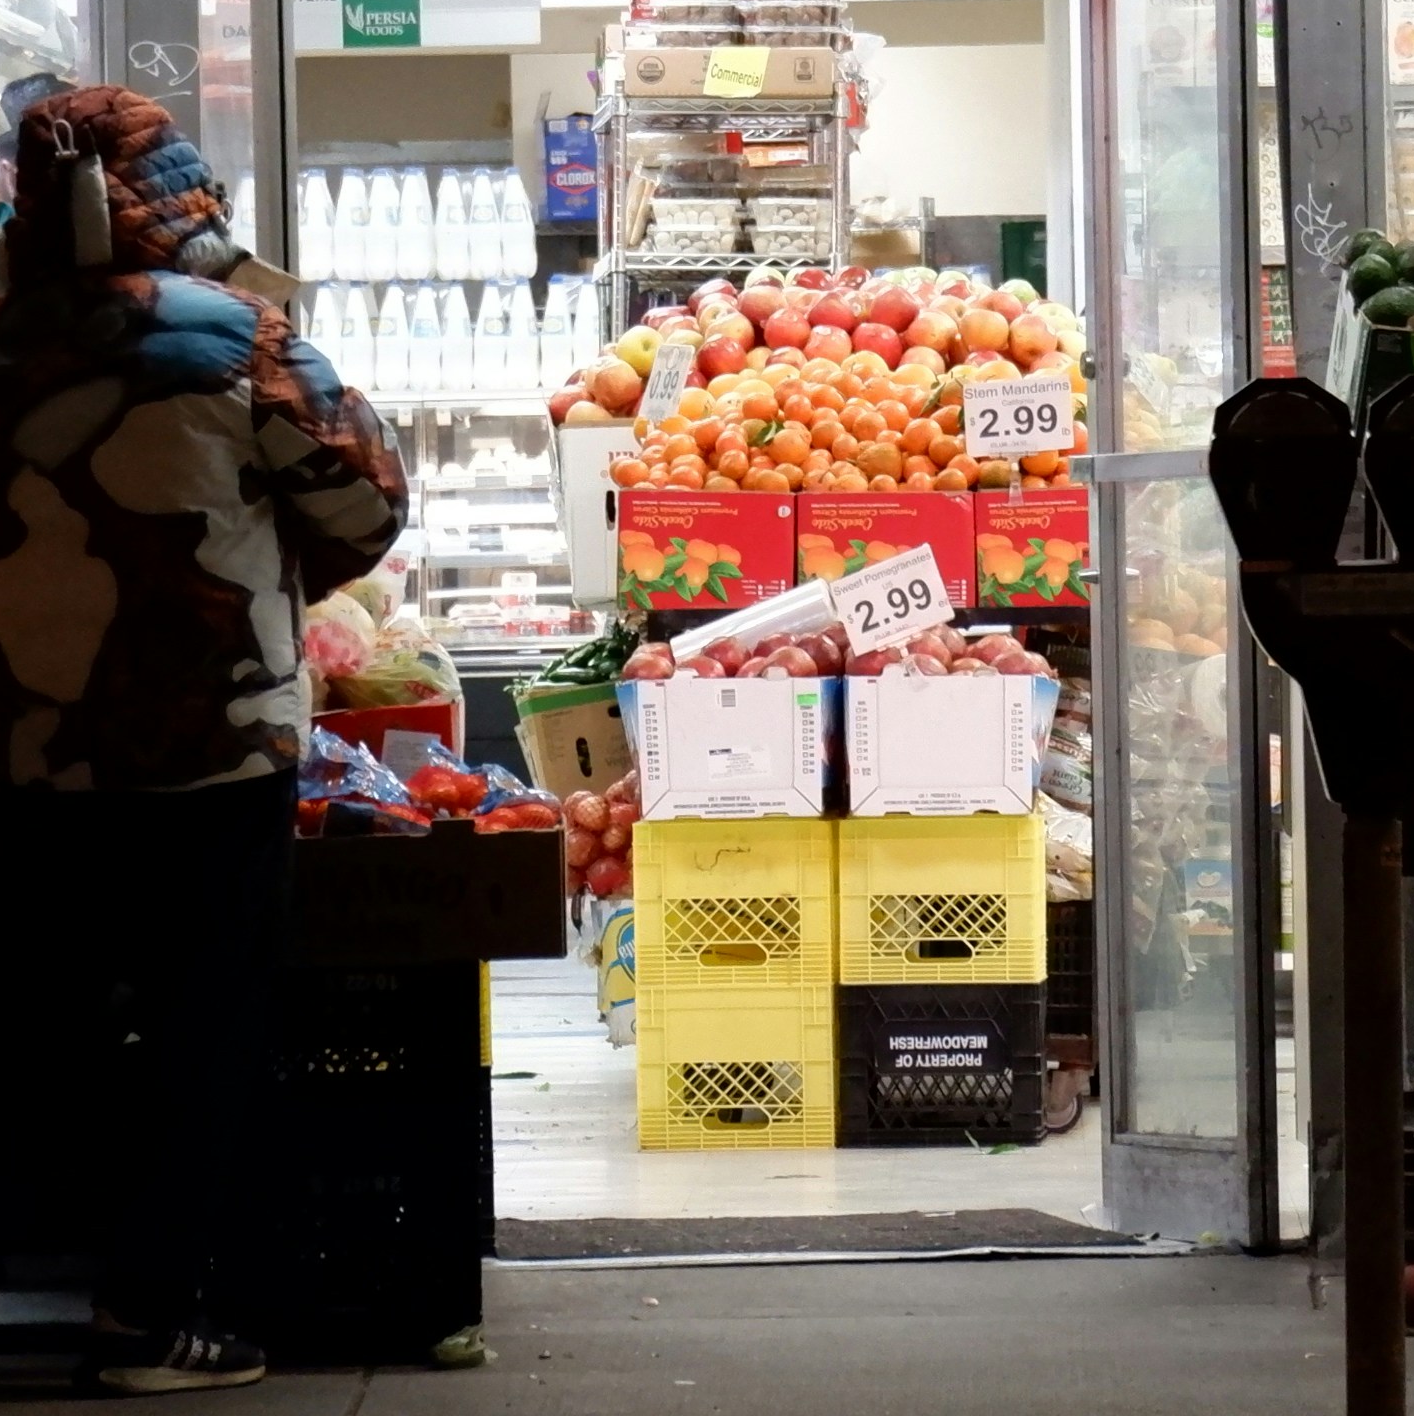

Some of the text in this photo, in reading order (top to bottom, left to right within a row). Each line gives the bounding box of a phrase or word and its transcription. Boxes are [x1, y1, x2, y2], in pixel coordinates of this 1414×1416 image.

[366, 11, 417, 25] PERSIA
[366, 25, 404, 36] FOODS
[710, 64, 763, 88] Commercial
[555, 173, 597, 186] CLOROX
[964, 380, 1070, 401] Stem Mandarins
[979, 403, 1058, 439] 2.99
[833, 551, 931, 596] Sweet Pomegranates
[854, 578, 932, 633] 2.99
[890, 1035, 987, 1050] MEADOWFRESH
[896, 1052, 983, 1068] PROPERTY OF
